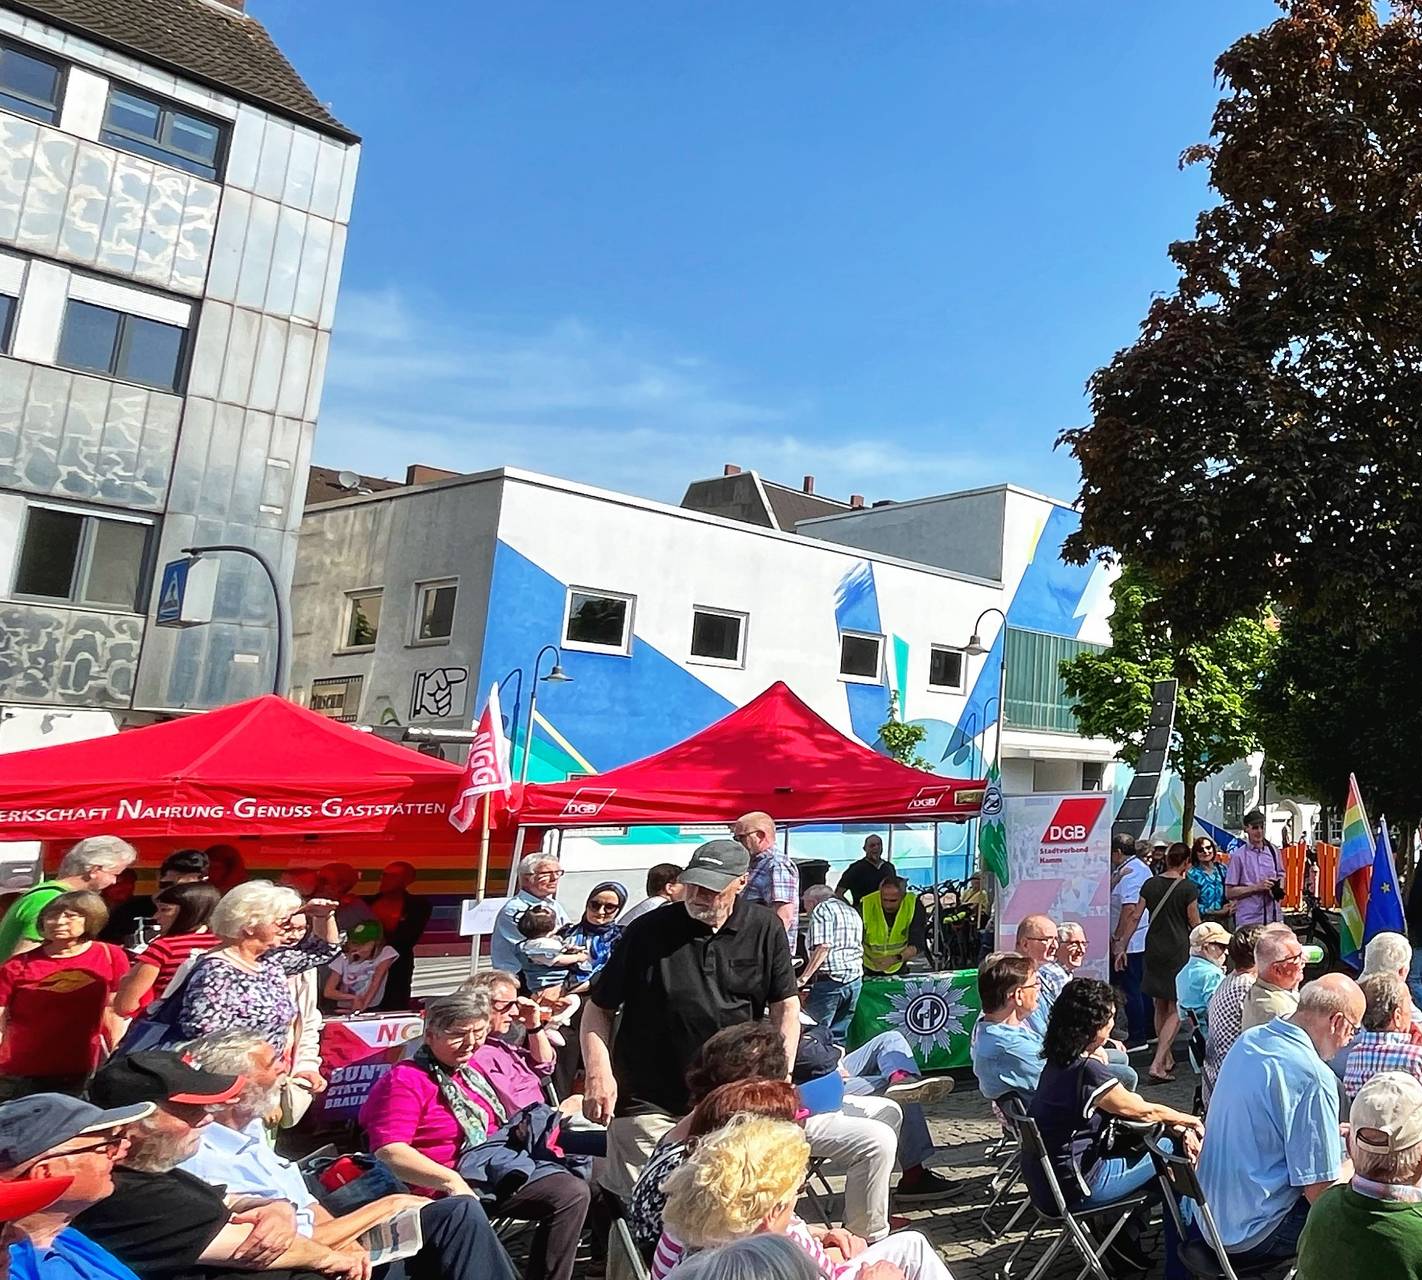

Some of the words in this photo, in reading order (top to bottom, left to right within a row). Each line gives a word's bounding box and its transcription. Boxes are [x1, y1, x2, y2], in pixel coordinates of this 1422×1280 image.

[469, 731, 497, 786] NGG
[568, 803, 597, 814] DGB
[913, 798, 936, 807] DGB
[1050, 825, 1087, 841] DGB
[1039, 846, 1089, 855] Stadtverband
[330, 1063, 393, 1083] BUNT
[327, 1082, 371, 1097] STATT
